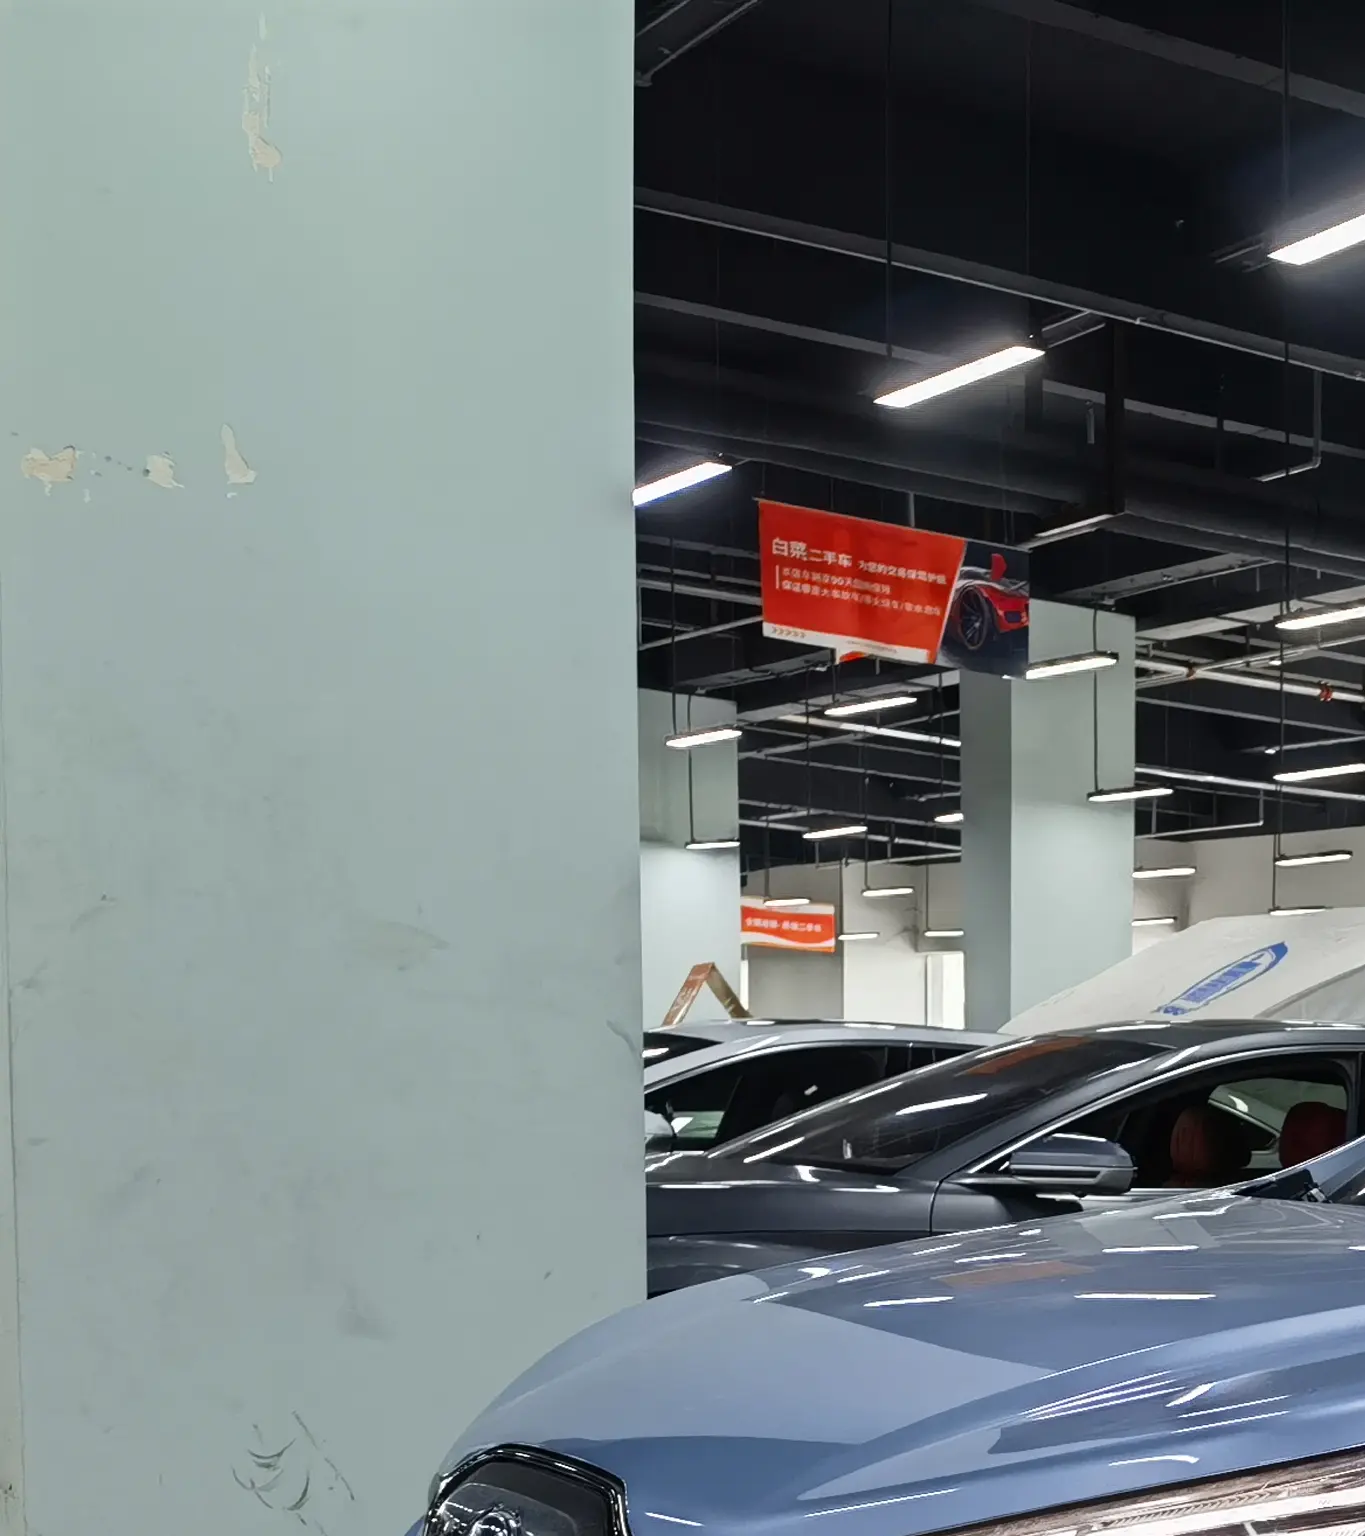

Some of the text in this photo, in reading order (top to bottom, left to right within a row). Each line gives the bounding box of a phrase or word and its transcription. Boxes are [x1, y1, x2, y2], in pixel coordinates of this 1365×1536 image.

[772, 537, 853, 568] 白菜二手车
